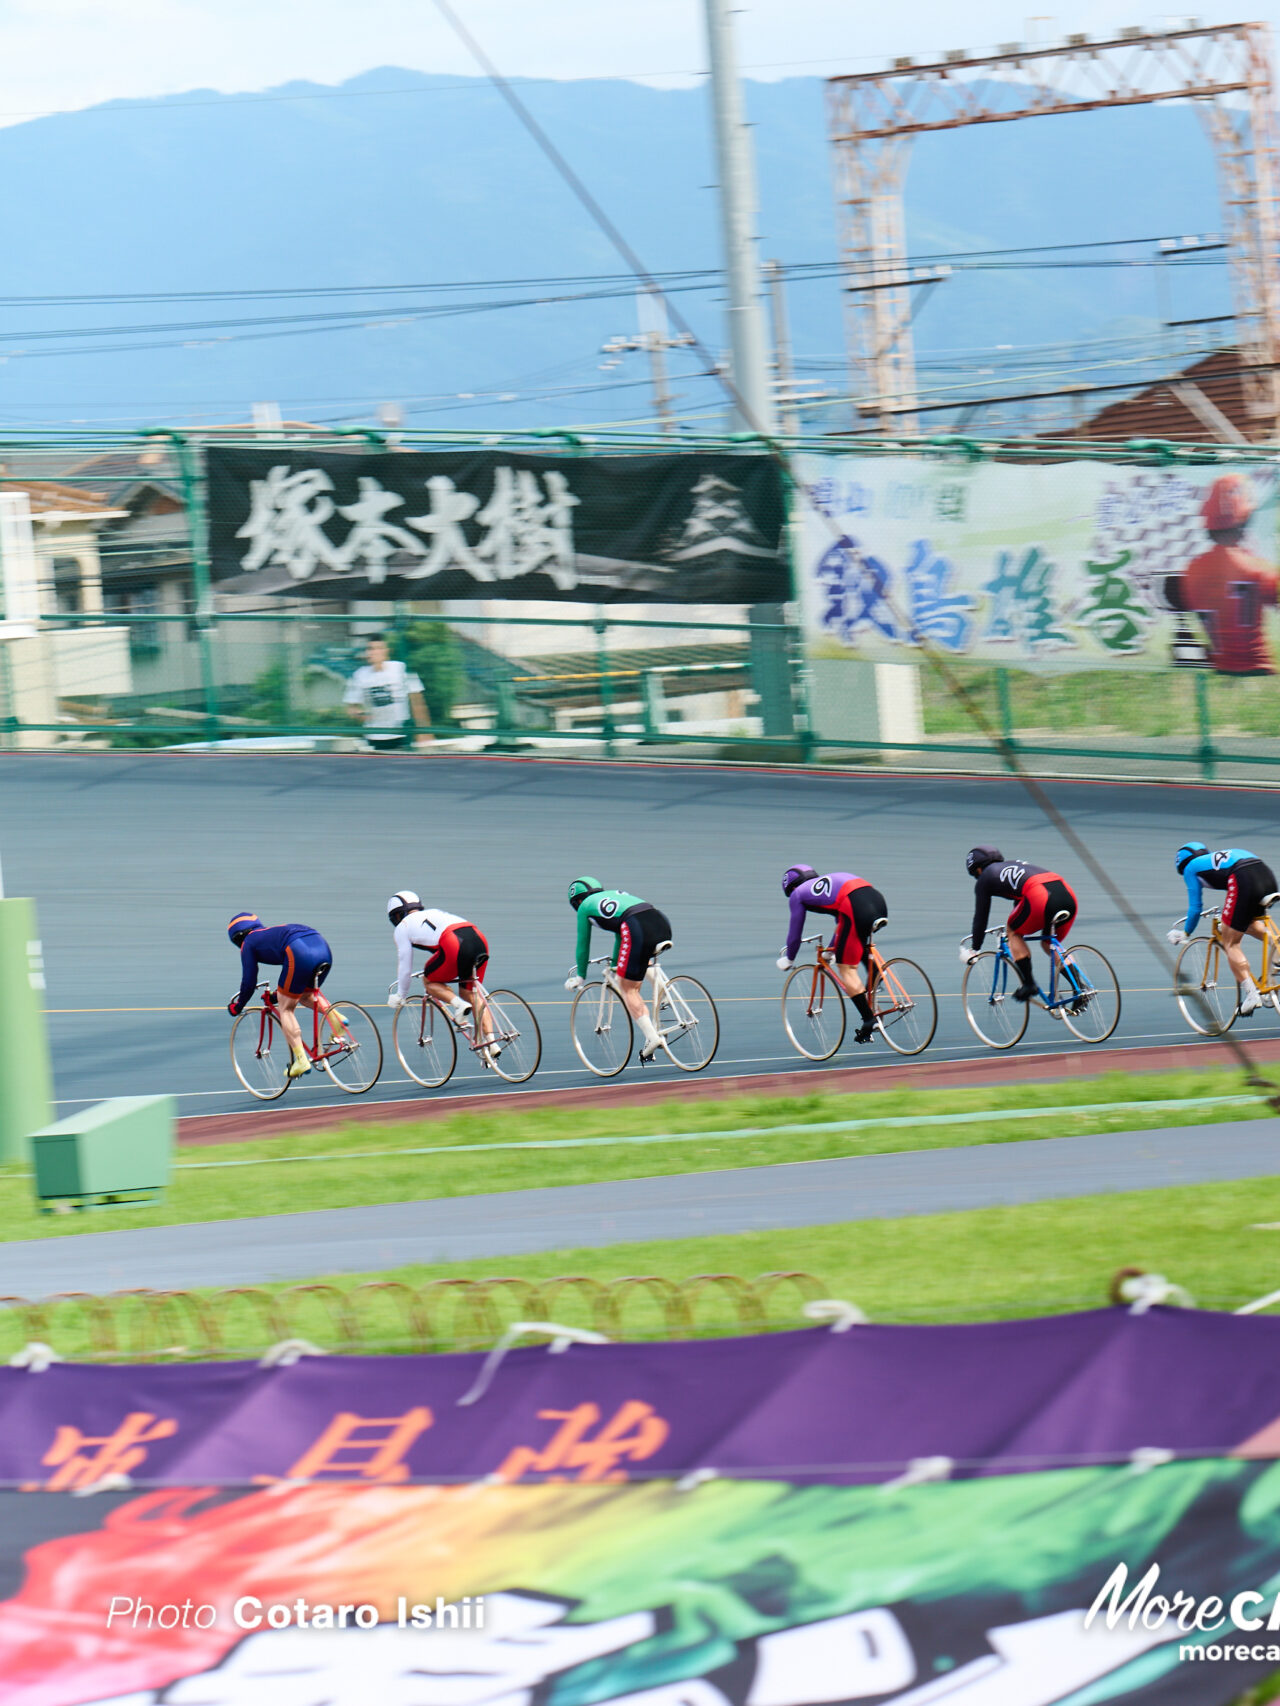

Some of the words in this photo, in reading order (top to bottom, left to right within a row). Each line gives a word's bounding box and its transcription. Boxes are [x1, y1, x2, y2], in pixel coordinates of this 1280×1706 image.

[235, 465, 581, 591] 塚本大樹
[1211, 850, 1232, 871] 4
[811, 876, 833, 898] 9
[1000, 865, 1026, 890] 2
[598, 898, 618, 919] 6
[421, 919, 436, 933] 1
